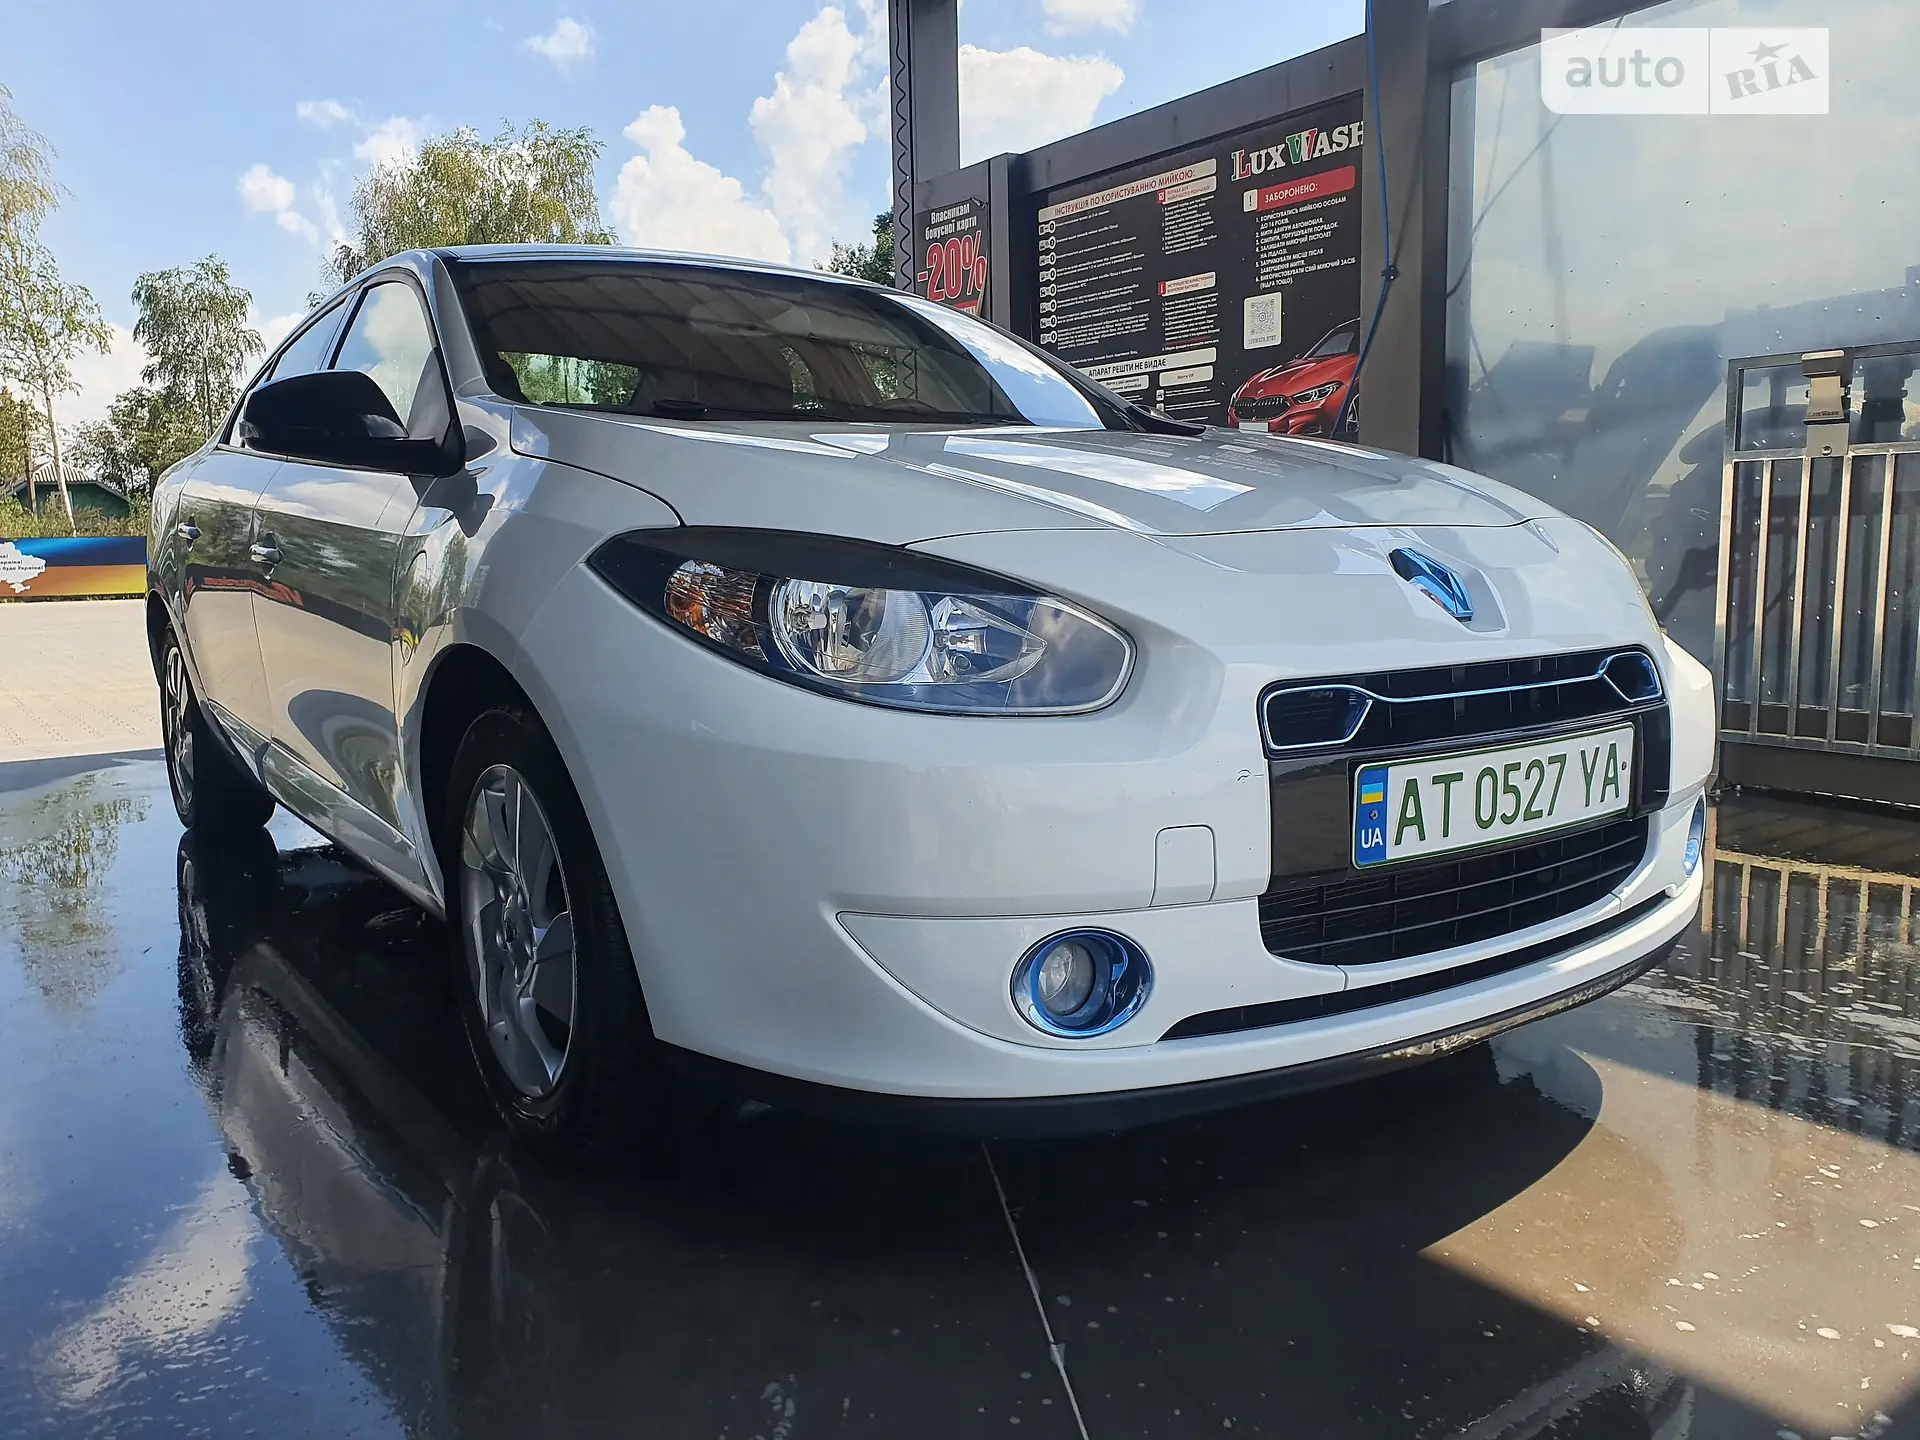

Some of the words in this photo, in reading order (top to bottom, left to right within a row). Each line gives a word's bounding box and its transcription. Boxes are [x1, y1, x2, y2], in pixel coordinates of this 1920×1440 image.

[1054, 200, 1088, 216] ІНСТРУКЦІЯ
[1090, 196, 1100, 205] ПО
[1102, 180, 1156, 203] КОРИСТУВАННЮ
[1158, 170, 1196, 187] МИЙКОЮ:
[1264, 182, 1318, 204] ЗАБОРОНЕНО:
[931, 203, 970, 224] Власникам
[925, 220, 955, 240] бонусної
[956, 216, 977, 231] карти
[917, 230, 987, 302] -20%
[1088, 367, 1112, 377] АПАРАТ
[1112, 363, 1134, 374] РЕШТИ
[1134, 362, 1143, 370] НЕ
[1144, 358, 1167, 369] ВИДАЄ
[1394, 771, 1464, 846] AT
[1474, 753, 1568, 830] 0527
[1579, 742, 1621, 808] YA
[1361, 826, 1384, 850] UA
